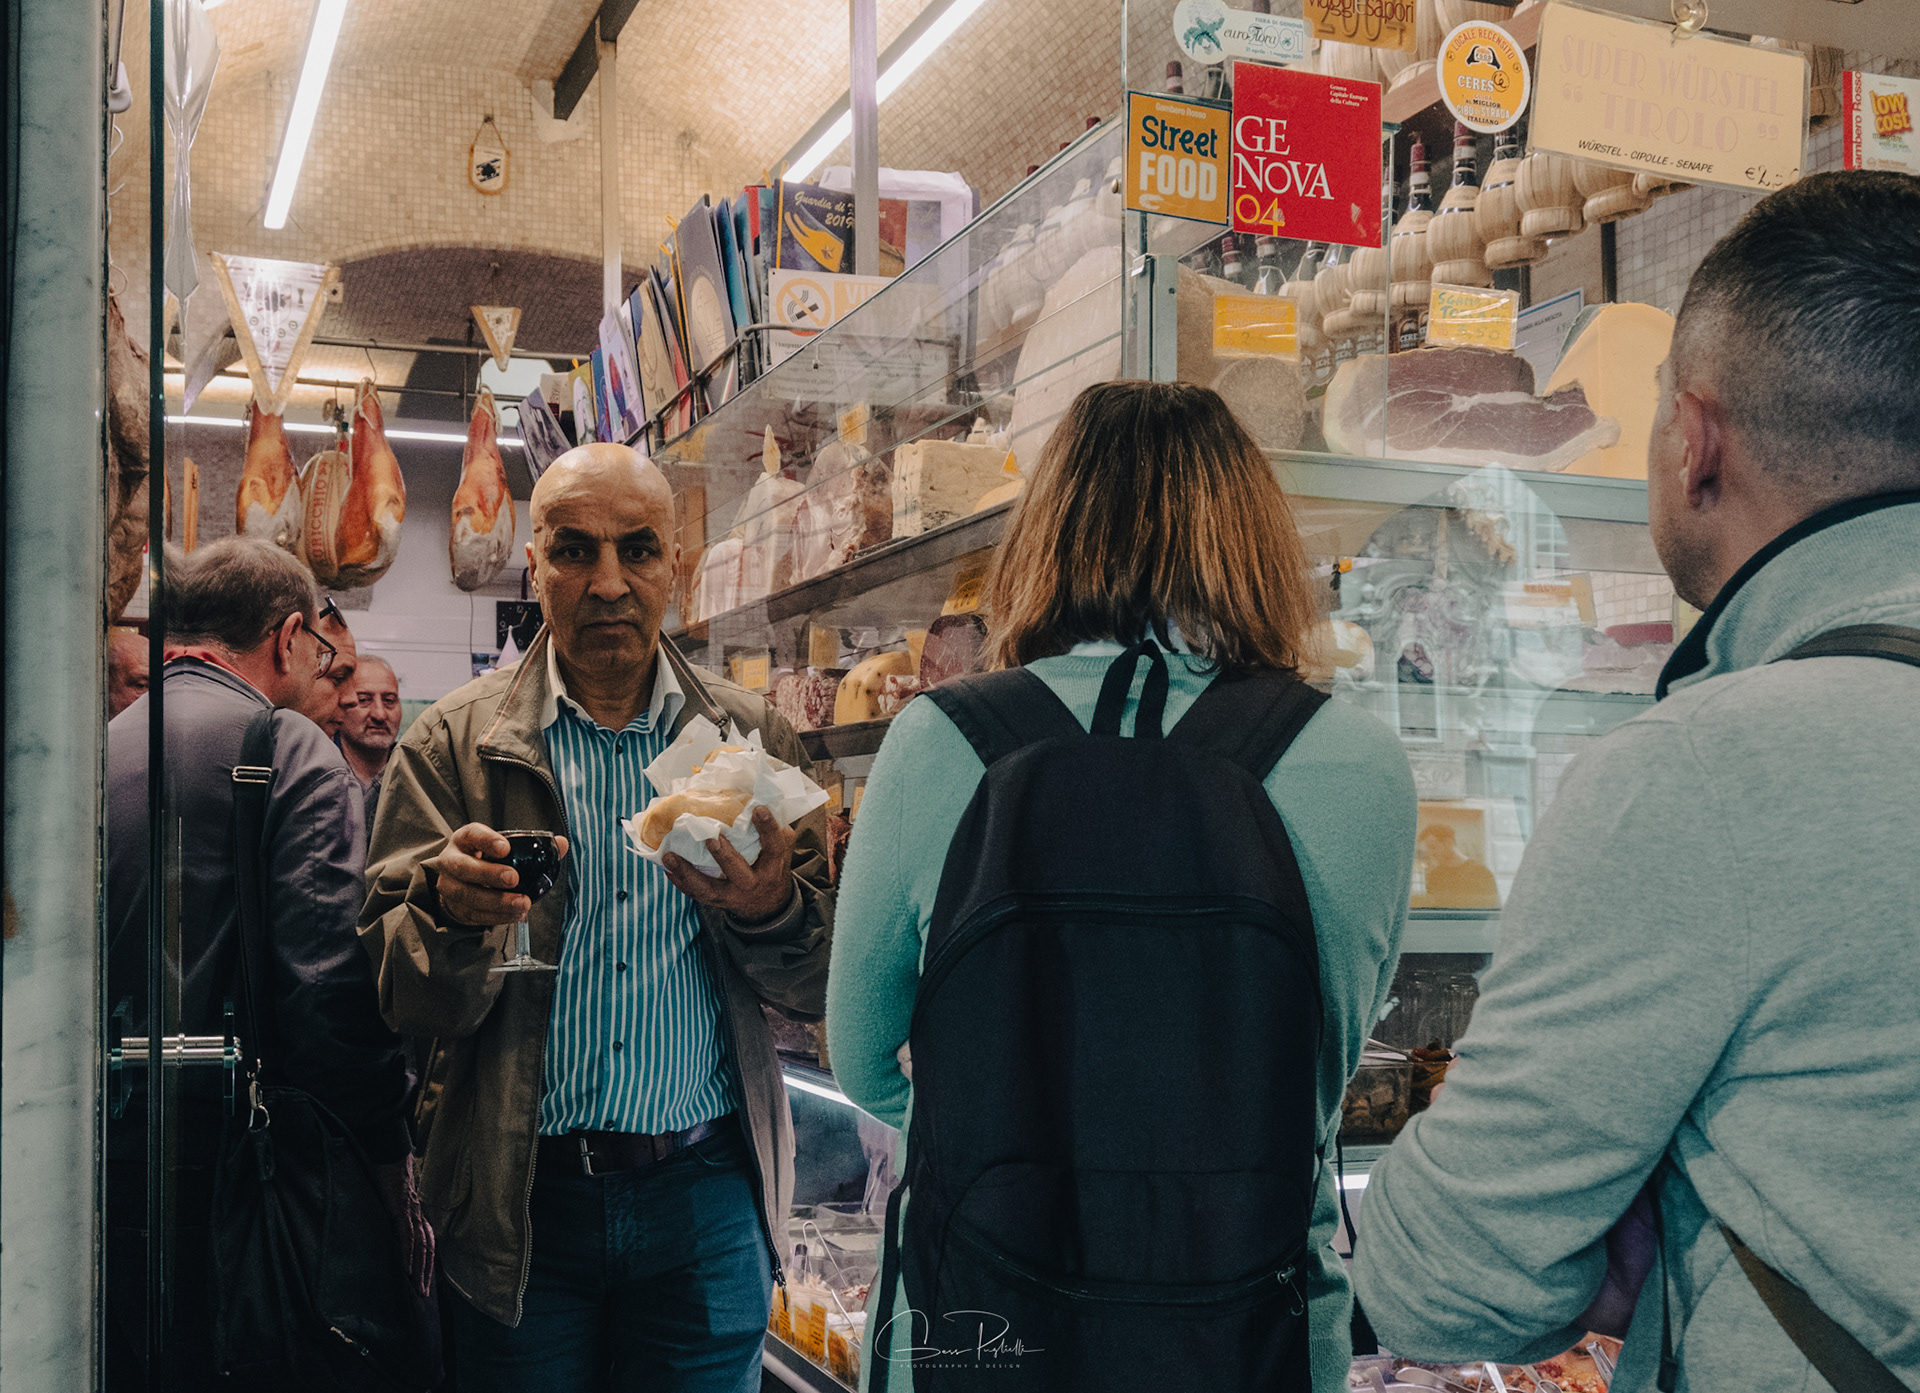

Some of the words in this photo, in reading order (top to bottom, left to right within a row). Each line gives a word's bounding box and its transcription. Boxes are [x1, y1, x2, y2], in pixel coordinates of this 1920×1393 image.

[1452, 28, 1476, 51] LOCALE
[1478, 28, 1515, 60] RECENSITO
[1457, 75, 1495, 93] CERES
[1560, 35, 1647, 91] SUPER
[1658, 54, 1784, 117] WÜRSTEL
[1852, 71, 1862, 111] Rosso
[1155, 102, 1185, 116] Gambero
[1186, 107, 1207, 119] Rosso
[1456, 104, 1474, 116] CIBO
[1481, 107, 1511, 120] STRADA
[1473, 99, 1501, 109] MIGLIOR
[1869, 89, 1906, 116] low
[1141, 114, 1218, 159] Street
[1235, 115, 1291, 155] GE
[1467, 116, 1499, 126] ITALIANO
[1600, 91, 1739, 153] TIROLO
[1874, 108, 1910, 134] cost
[1578, 139, 1622, 157] WÜRSTEL
[1630, 150, 1669, 166] CIPOLLE
[1676, 159, 1714, 174] SENAPE
[1139, 151, 1218, 202] FOOD
[1234, 152, 1335, 200] NOVA
[794, 190, 832, 211] Guardia
[834, 202, 846, 212] di
[1235, 194, 1286, 236] 04
[825, 212, 856, 229] 2019
